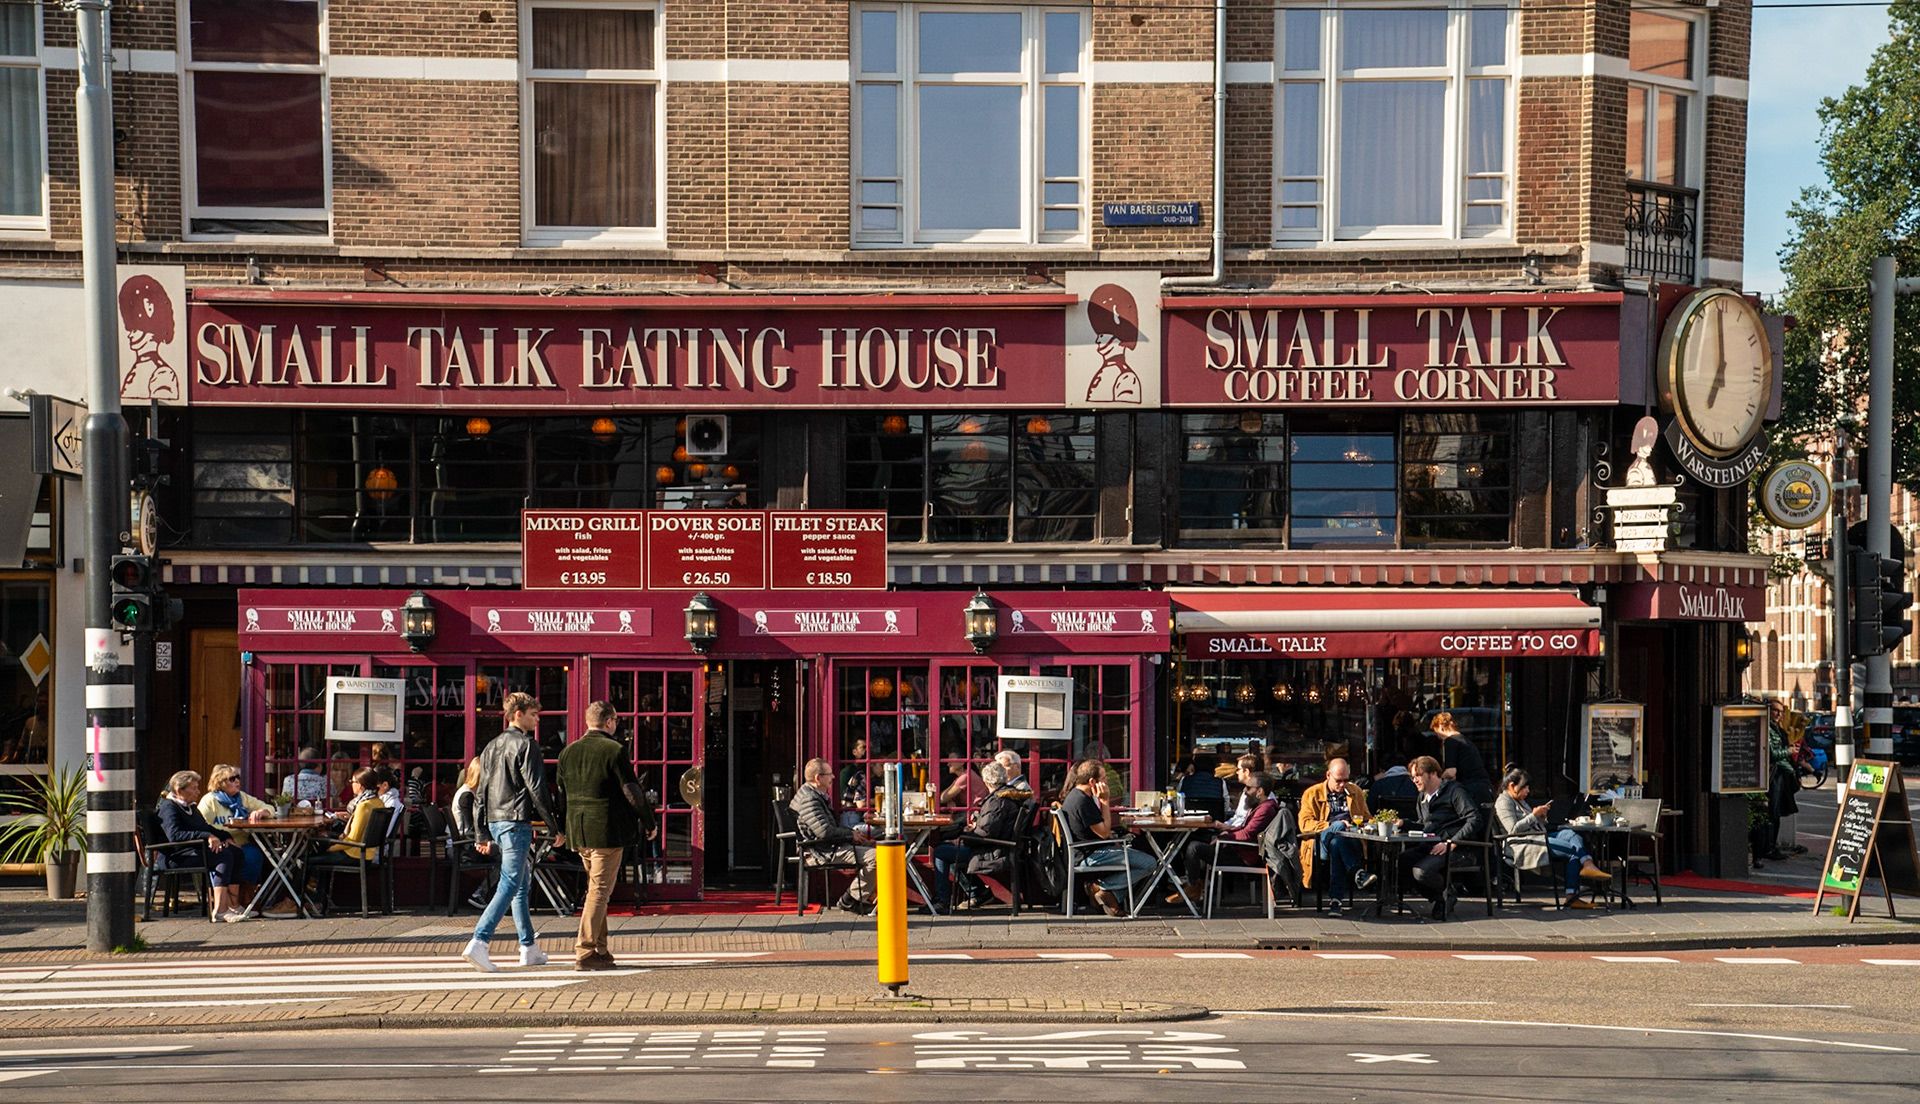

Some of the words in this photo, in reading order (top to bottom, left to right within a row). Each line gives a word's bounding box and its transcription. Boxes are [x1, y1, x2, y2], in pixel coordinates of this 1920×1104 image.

[1108, 205, 1127, 215] VAN
[1130, 205, 1194, 215] BAERLESTRAAT
[1205, 307, 1388, 371] SMALL
[1417, 308, 1566, 367] TALK
[197, 322, 387, 385] SMALL
[407, 327, 556, 386] TALK
[579, 328, 790, 389] EATING
[818, 327, 997, 388] HOUSE
[1223, 368, 1373, 402] COFFEE
[1393, 368, 1559, 401] CORNER
[1676, 433, 1763, 484] WARSTEINER
[526, 517, 584, 531] MIXED
[588, 517, 640, 531] GRILL
[651, 517, 713, 532] DOVER
[718, 517, 762, 532] SOLE
[773, 517, 822, 532] FILET
[825, 517, 884, 532] STEAK
[574, 532, 592, 540] fish
[802, 533, 830, 541] pepper
[571, 547, 591, 555] salad,
[695, 547, 715, 555] salad,
[801, 547, 816, 555] with
[817, 547, 837, 555] salad,
[572, 554, 609, 562] vegetables
[696, 554, 732, 562] vegetables
[818, 554, 854, 562] vegetables
[560, 571, 570, 585] €
[572, 571, 607, 585] 13.95
[682, 572, 692, 585] €
[694, 571, 731, 585] 26.50
[806, 572, 816, 585] €
[817, 571, 852, 585] 18.50
[1679, 585, 1717, 617] SMALL
[1715, 588, 1746, 619] TALK
[287, 611, 324, 623] SMALL
[326, 611, 356, 624] TALK
[527, 612, 563, 624] SMALL
[565, 612, 595, 625] TALK
[794, 612, 830, 625] SMALL
[831, 612, 861, 625] TALK
[1051, 612, 1086, 624] SMALL
[1087, 612, 1117, 624] TALK
[293, 622, 323, 631] EATING
[325, 622, 352, 631] HOUSE
[533, 623, 563, 632] EATING
[564, 623, 590, 632] HOUSE
[800, 624, 829, 632] EATING
[831, 624, 857, 632] HOUSE
[1056, 623, 1086, 632] EATING
[1087, 623, 1113, 632] HOUSE
[1209, 638, 1272, 653] SMALL
[1277, 637, 1327, 652] TALK
[1440, 636, 1513, 651] COFFEE
[1517, 636, 1545, 650] TO
[1549, 634, 1578, 650] GO
[346, 681, 395, 689] WARSTEINER
[1017, 679, 1064, 688] WARSTEINER
